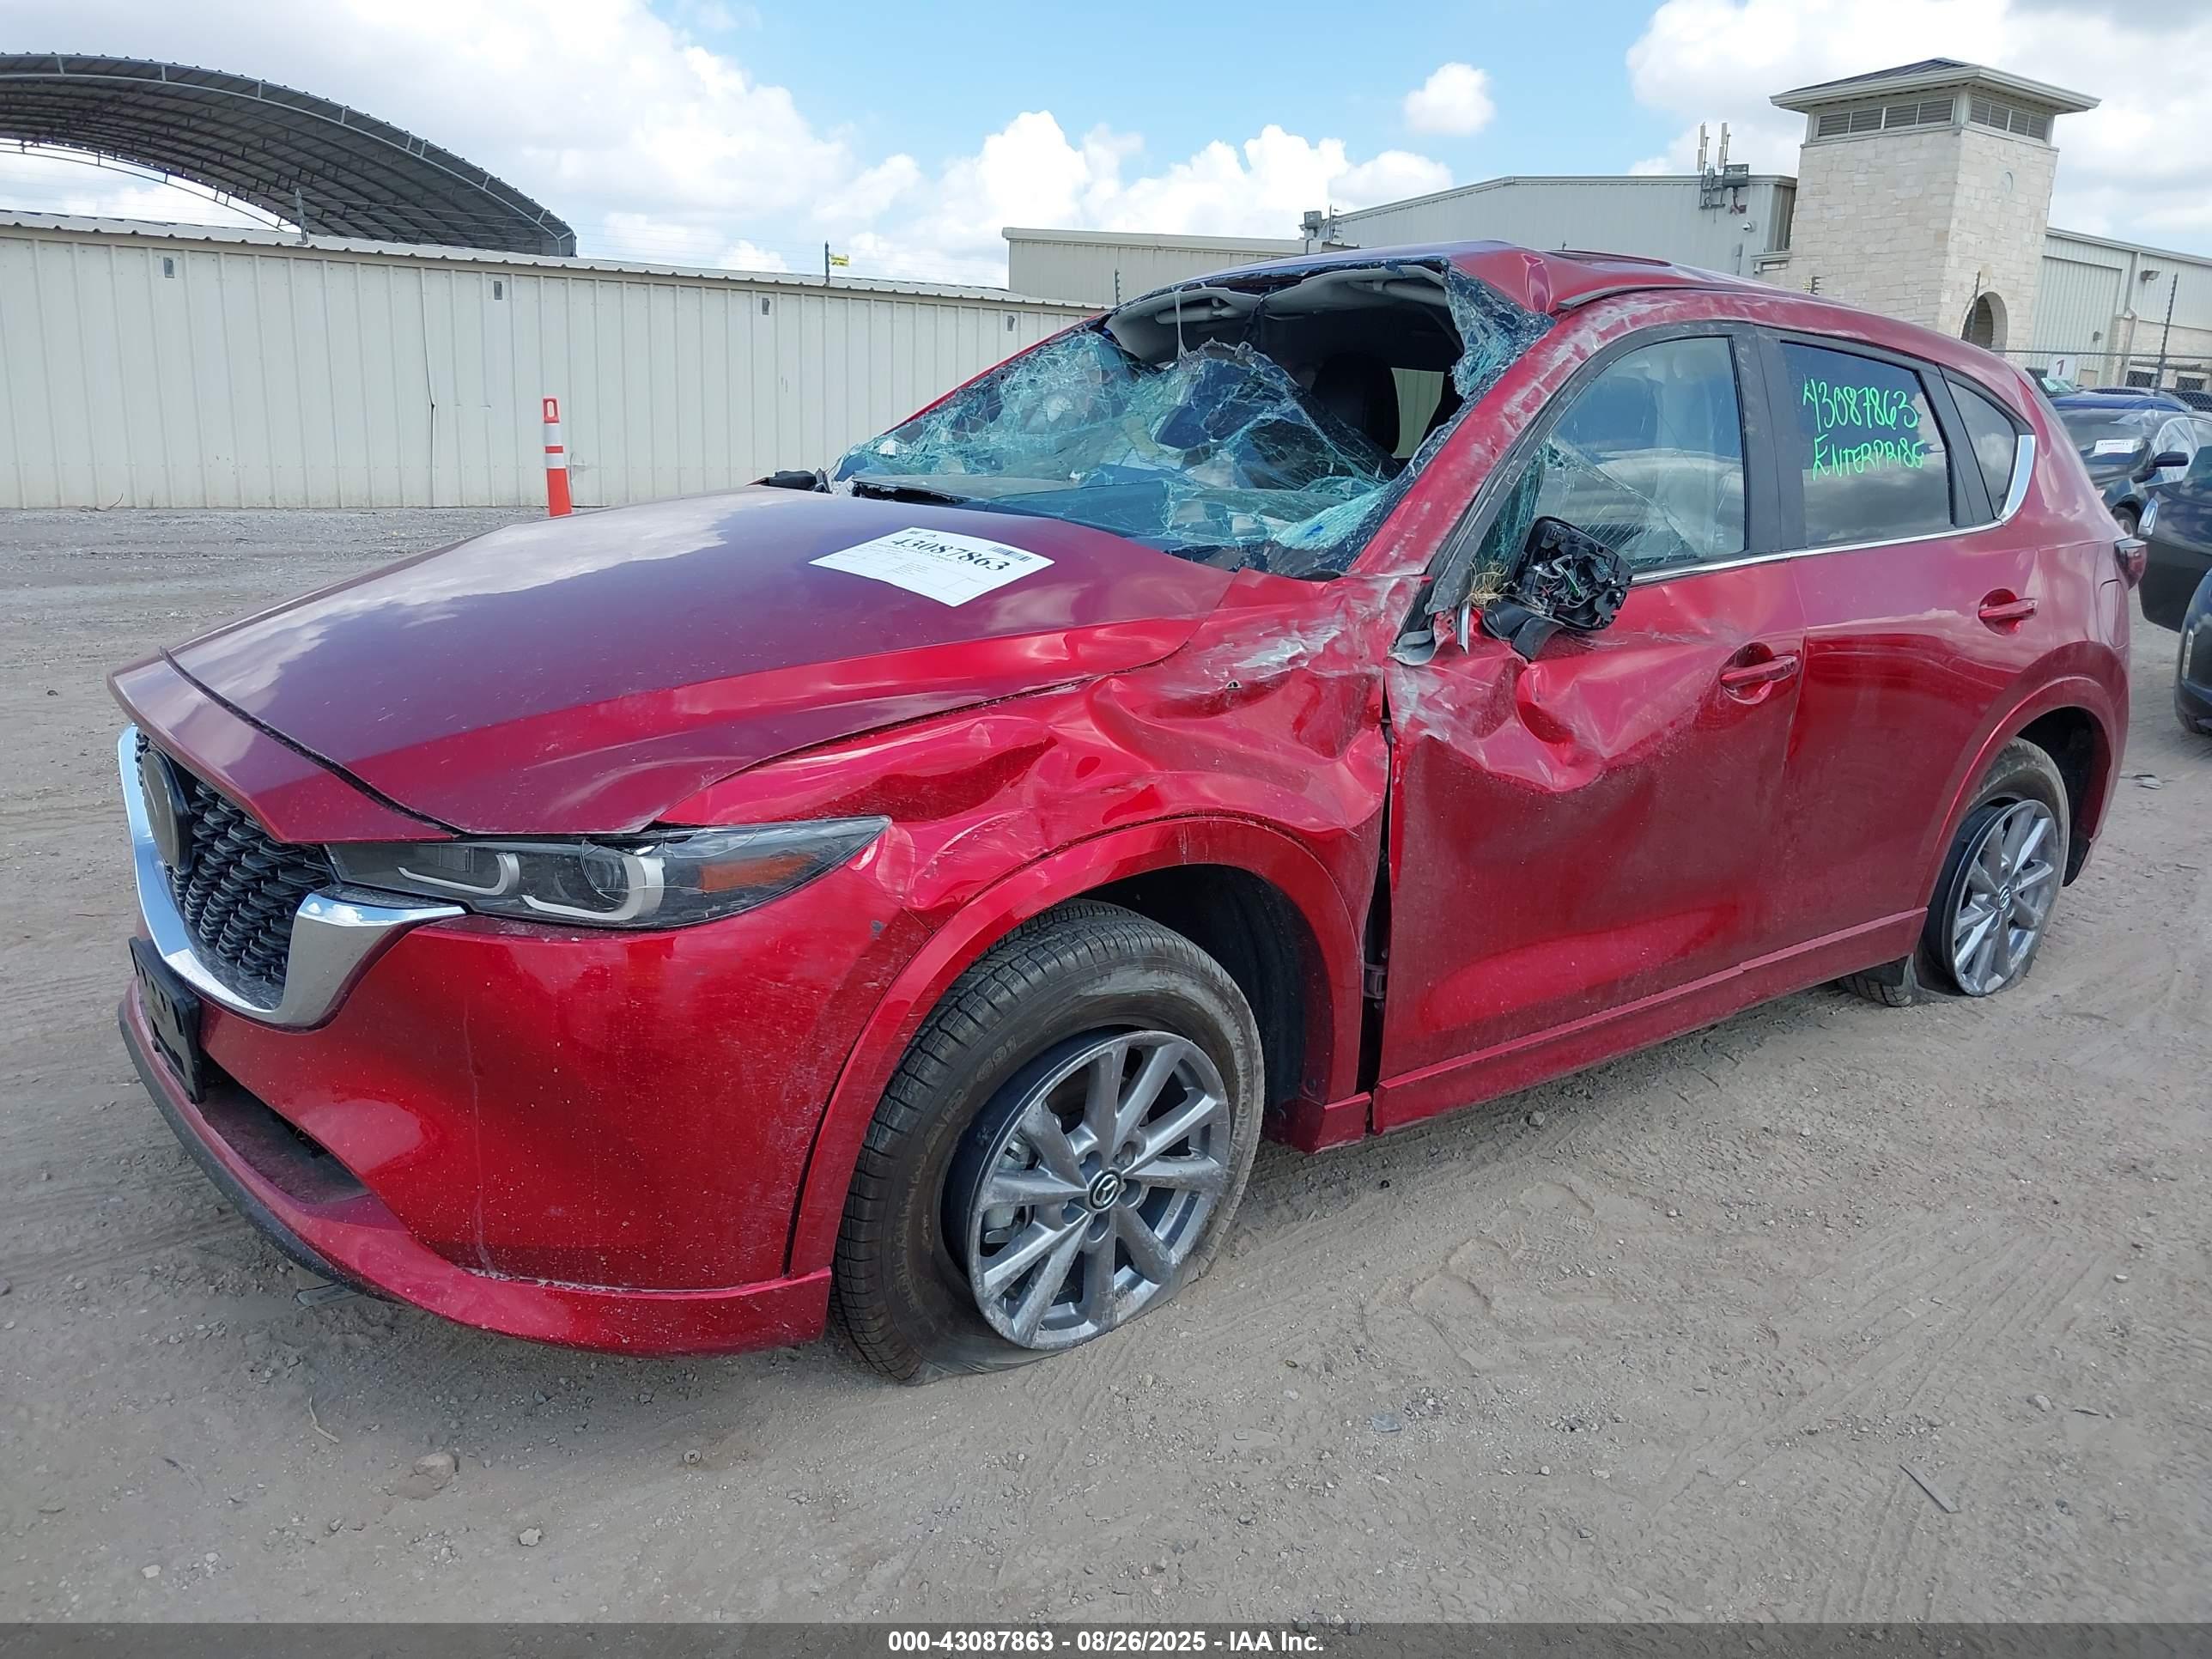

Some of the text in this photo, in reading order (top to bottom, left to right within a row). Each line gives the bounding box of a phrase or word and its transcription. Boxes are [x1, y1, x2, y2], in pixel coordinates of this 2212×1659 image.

[2056, 359, 2065, 376] 1
[1802, 374, 1918, 433] 43087863
[891, 538, 1011, 571] 43087863
